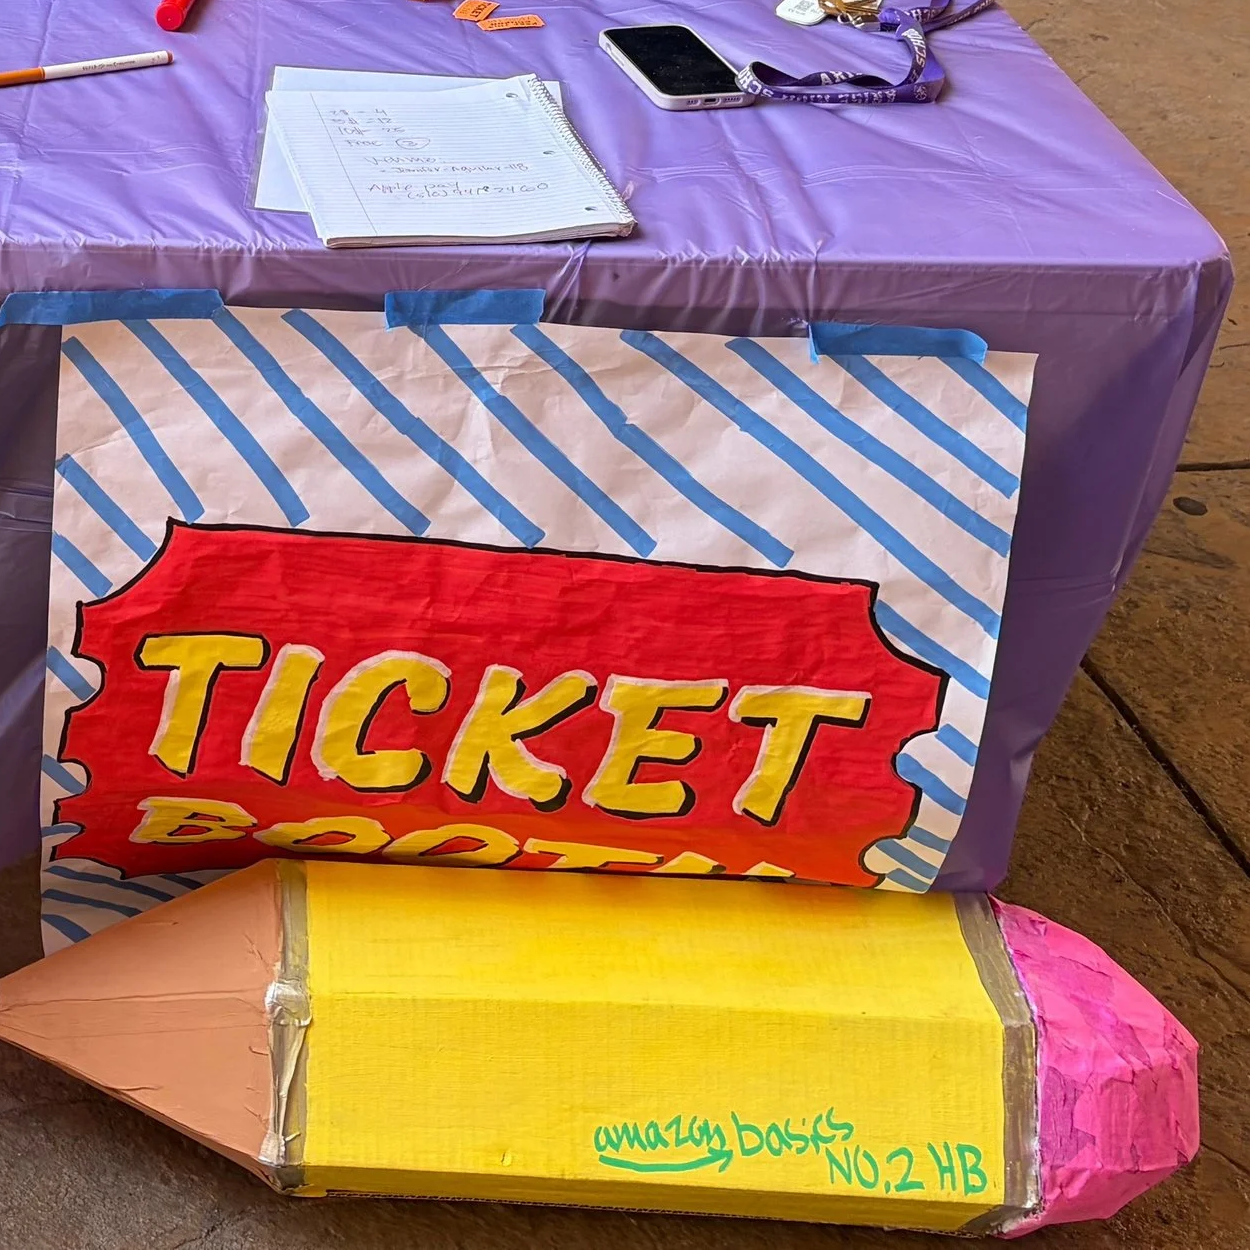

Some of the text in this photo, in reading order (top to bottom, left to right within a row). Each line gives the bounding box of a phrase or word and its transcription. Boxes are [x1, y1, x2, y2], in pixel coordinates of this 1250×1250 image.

[134, 632, 872, 828] TICKET
[594, 1112, 726, 1156] amazon
[938, 1141, 988, 1196] HB
